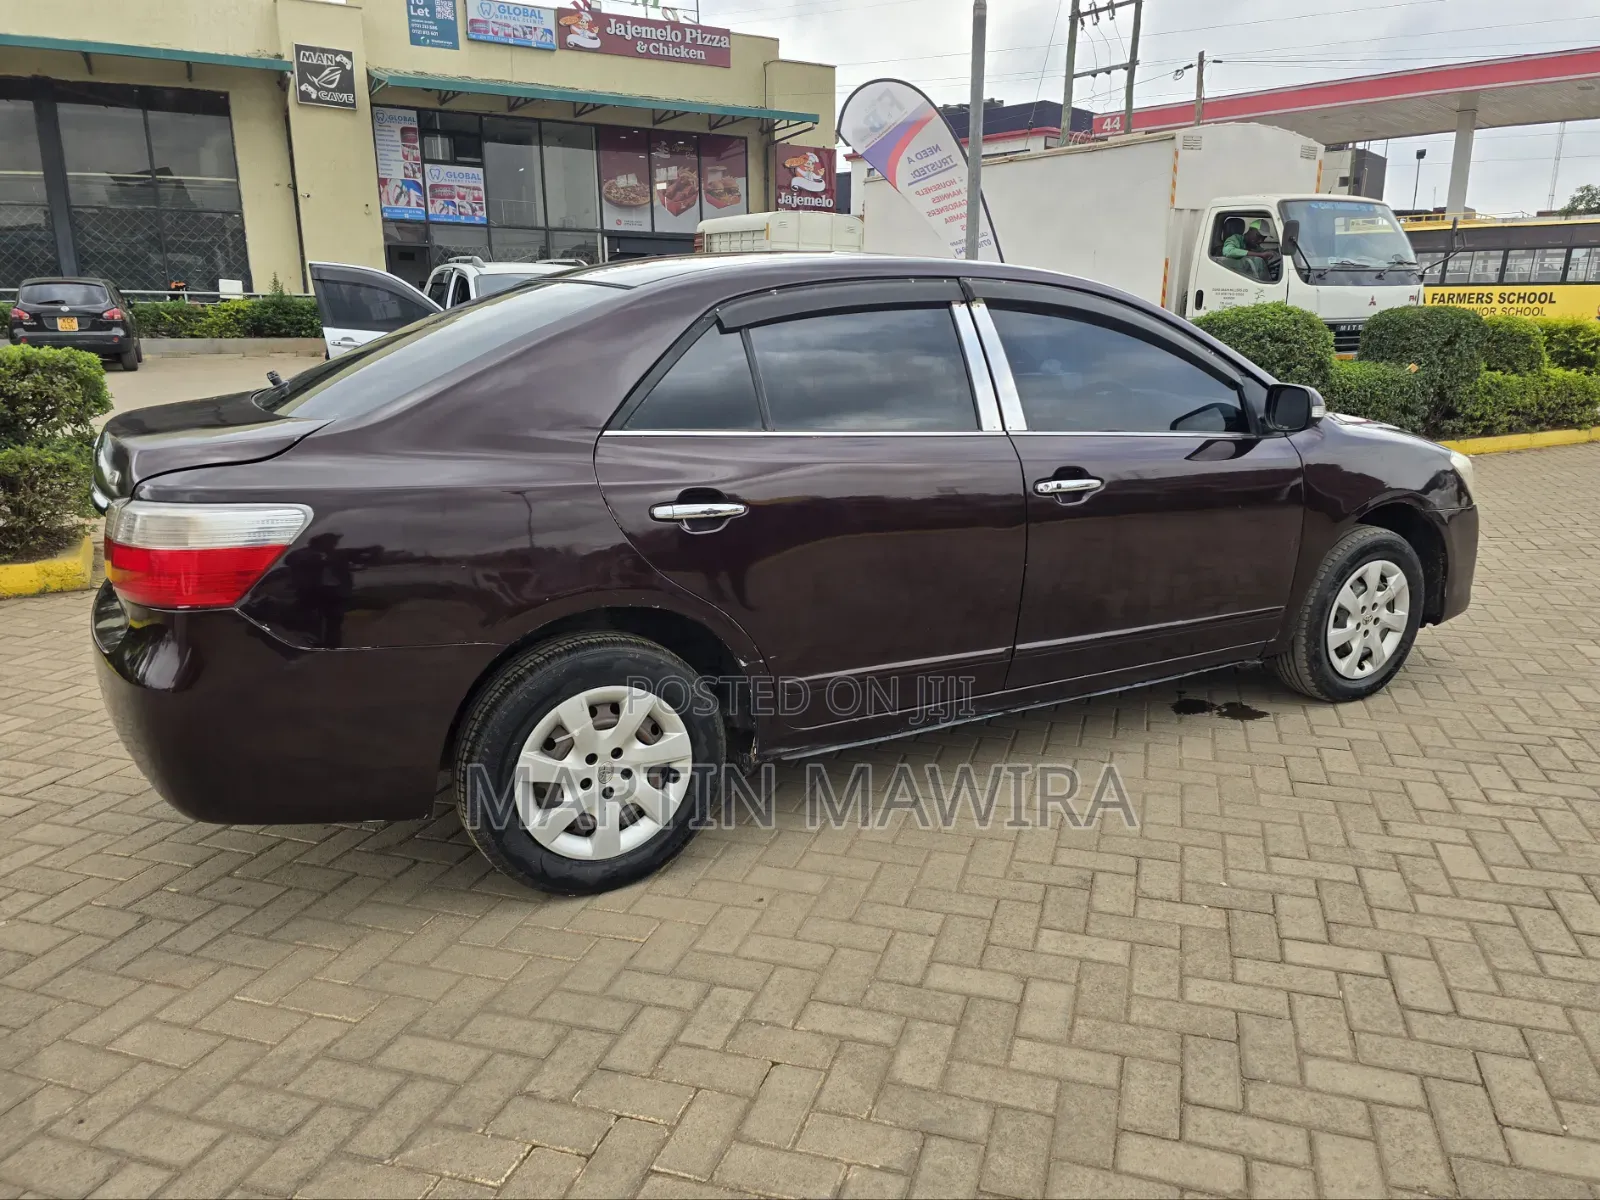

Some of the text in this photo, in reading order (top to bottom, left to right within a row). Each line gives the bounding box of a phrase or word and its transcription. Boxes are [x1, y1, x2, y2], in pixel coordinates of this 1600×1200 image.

[410, 5, 430, 17] Let
[497, 4, 543, 20] GLOBAL
[606, 18, 731, 48] Jajemelo Pizza
[636, 41, 706, 60] & Chicken
[300, 50, 335, 66] MAN
[318, 90, 355, 104] CAVE
[388, 114, 416, 123] GLOBAL
[1102, 116, 1121, 131] 44
[445, 171, 482, 180] GLOBAL
[778, 191, 834, 208] Jajemelo
[1431, 292, 1493, 304] FARMERS
[1497, 292, 1556, 304] SCHOOL
[1500, 306, 1546, 317] SCHOOL
